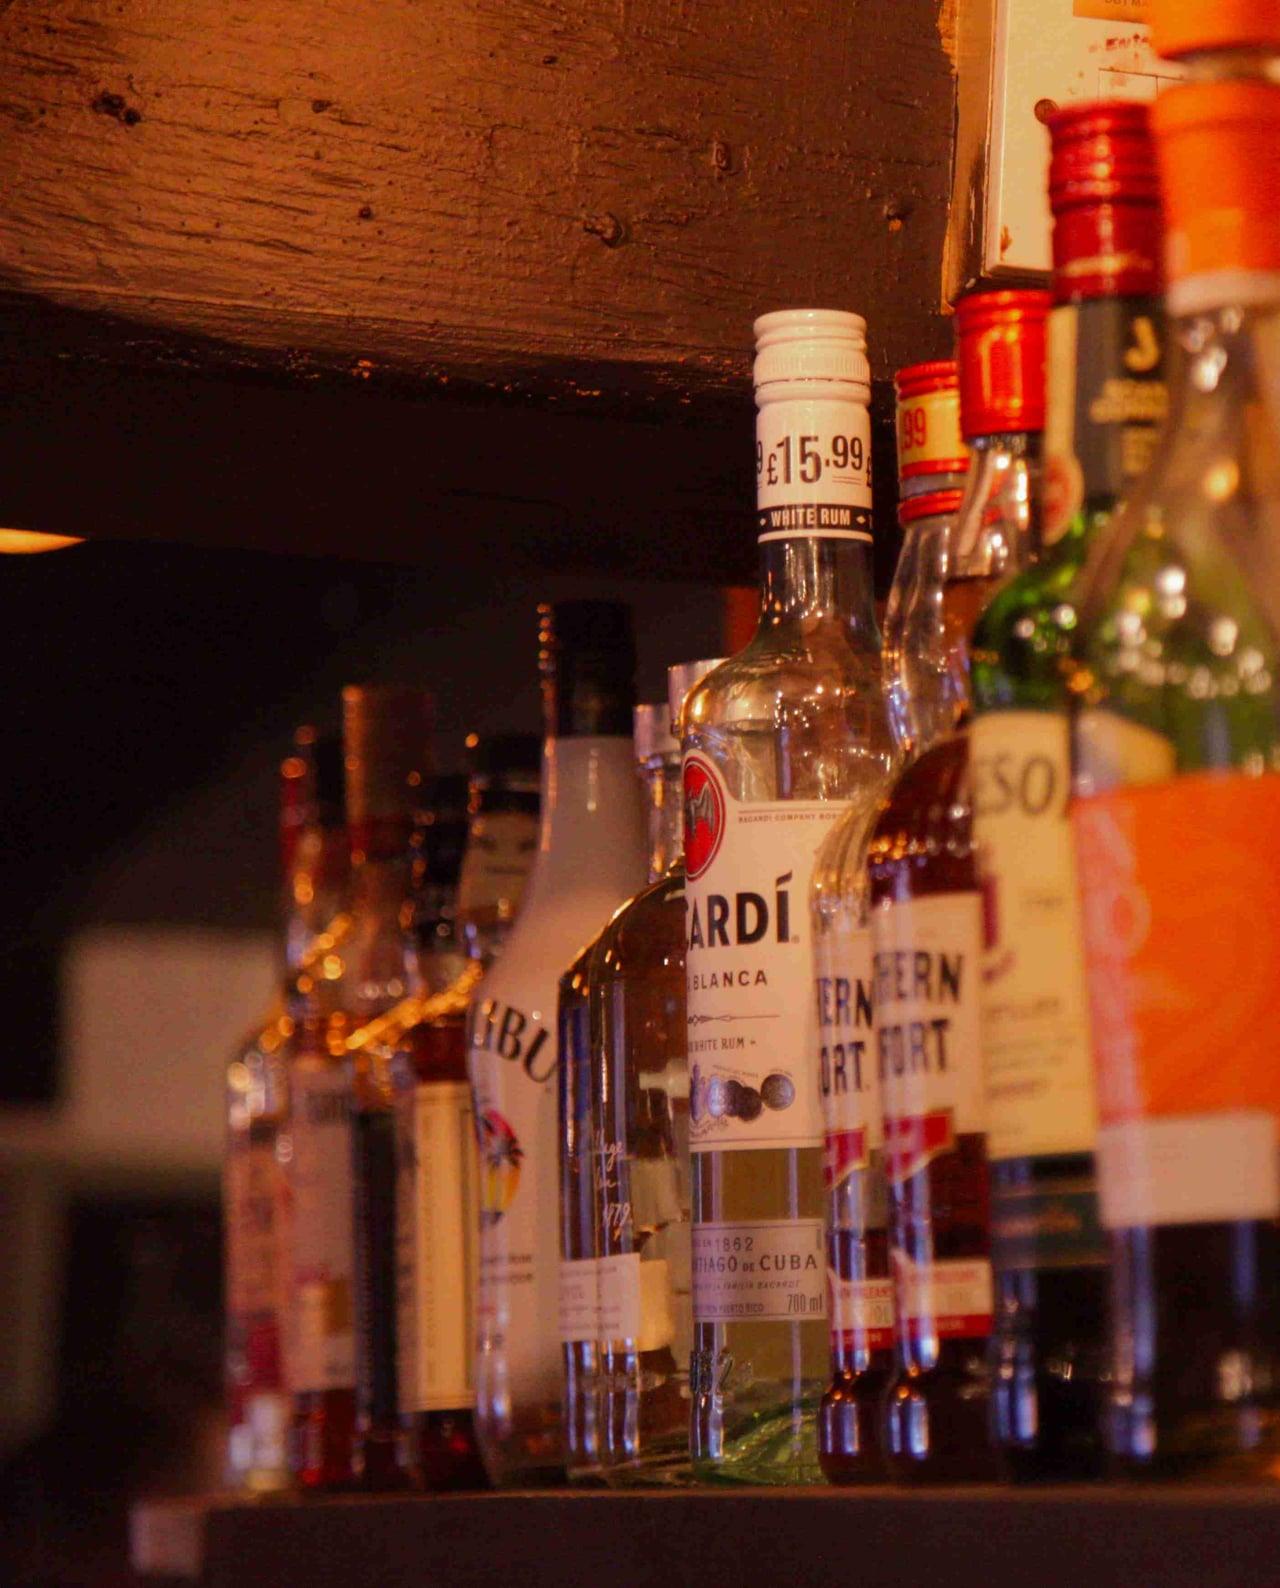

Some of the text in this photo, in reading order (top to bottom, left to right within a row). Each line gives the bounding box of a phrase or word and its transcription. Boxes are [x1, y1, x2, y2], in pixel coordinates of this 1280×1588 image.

[767, 435, 863, 486] £15.99
[770, 507, 850, 527] WHITE RUM
[685, 868, 792, 951] ARDÍ
[693, 970, 768, 990] BLANCA
[721, 1037, 746, 1050] RUM
[714, 1236, 754, 1252] 1862
[759, 1253, 818, 1272] CUBA
[787, 1293, 823, 1313] 700 ml
